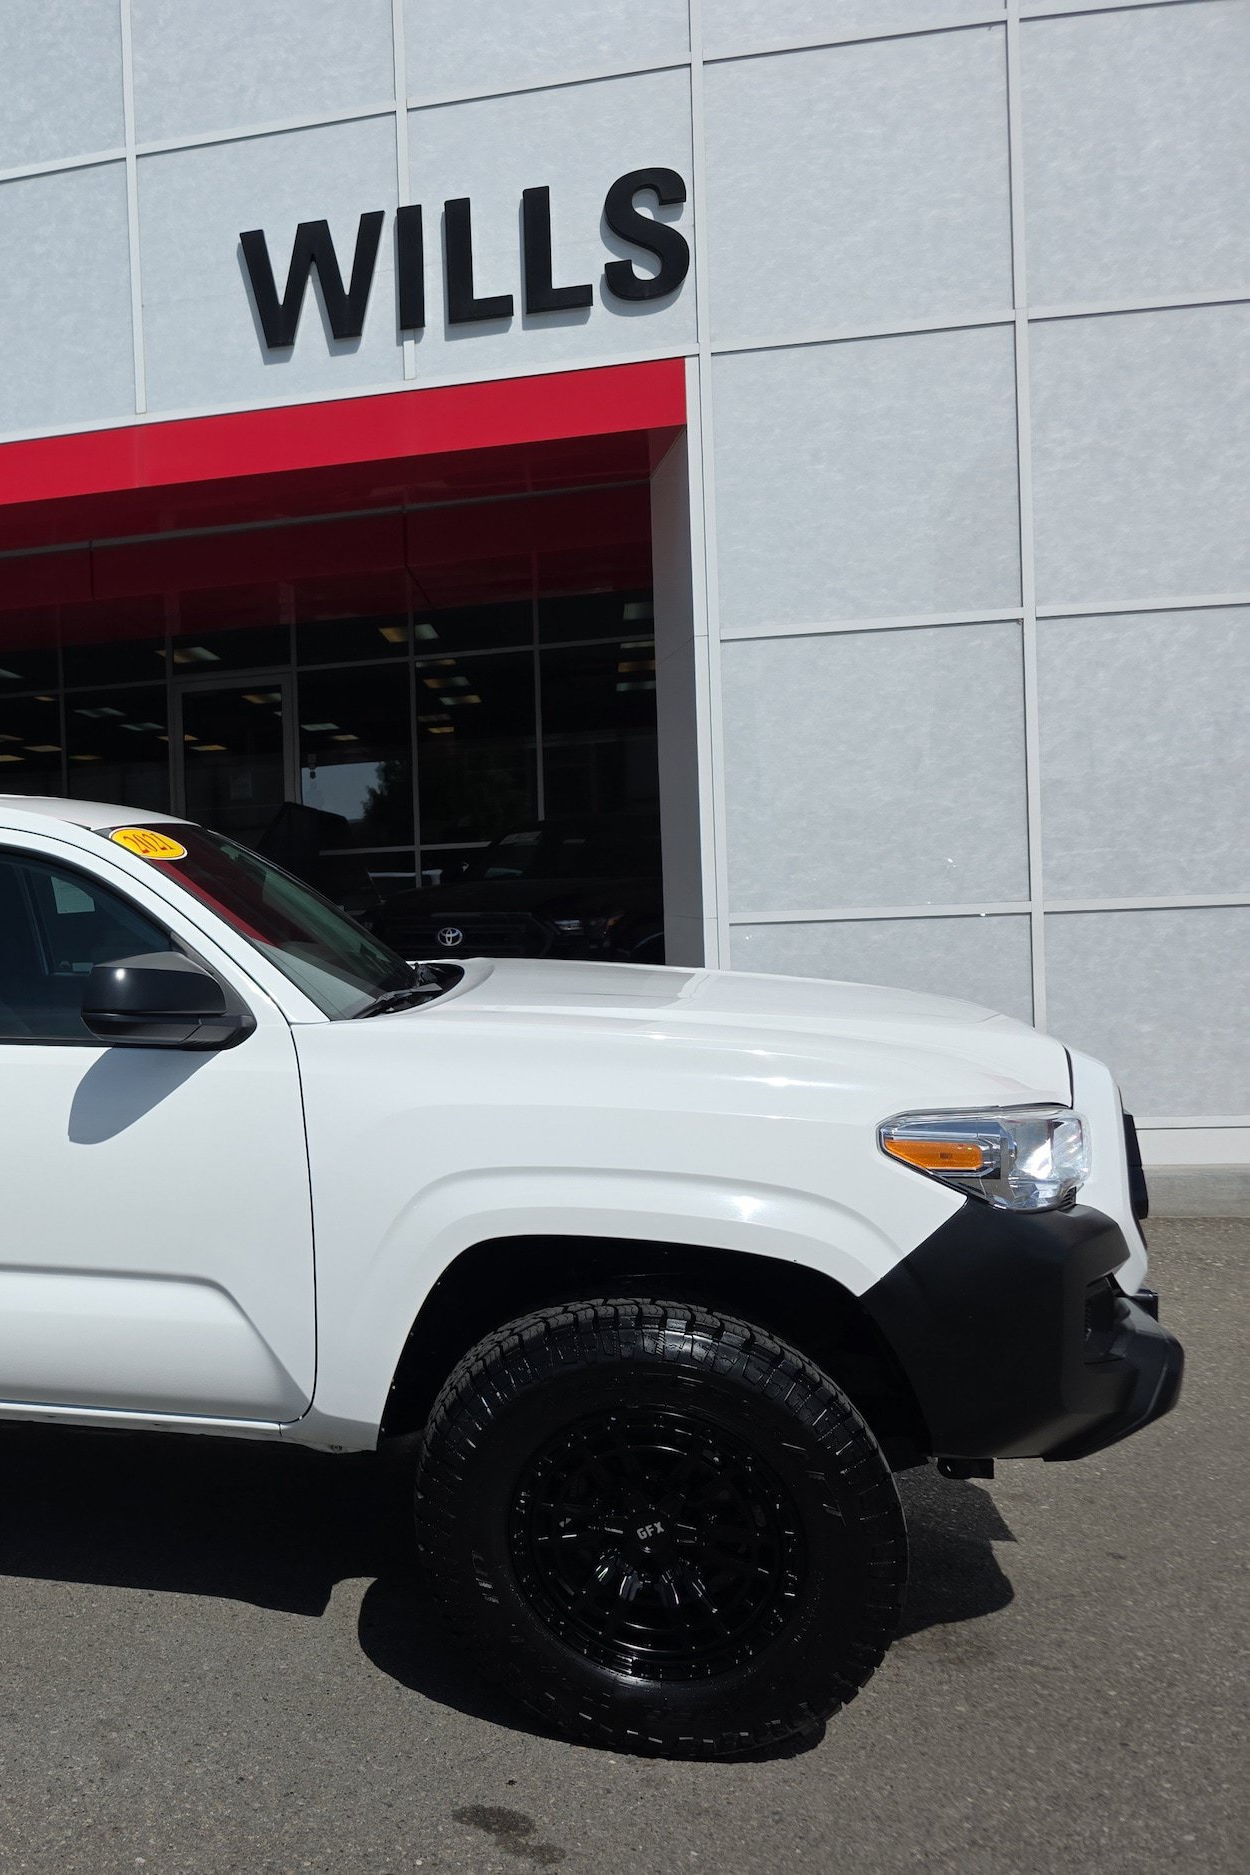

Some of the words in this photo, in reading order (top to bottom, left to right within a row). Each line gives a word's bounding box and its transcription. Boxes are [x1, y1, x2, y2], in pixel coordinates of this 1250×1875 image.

[239, 167, 690, 348] WILLS
[123, 832, 175, 854] 2021
[636, 1521, 665, 1540] GFX
